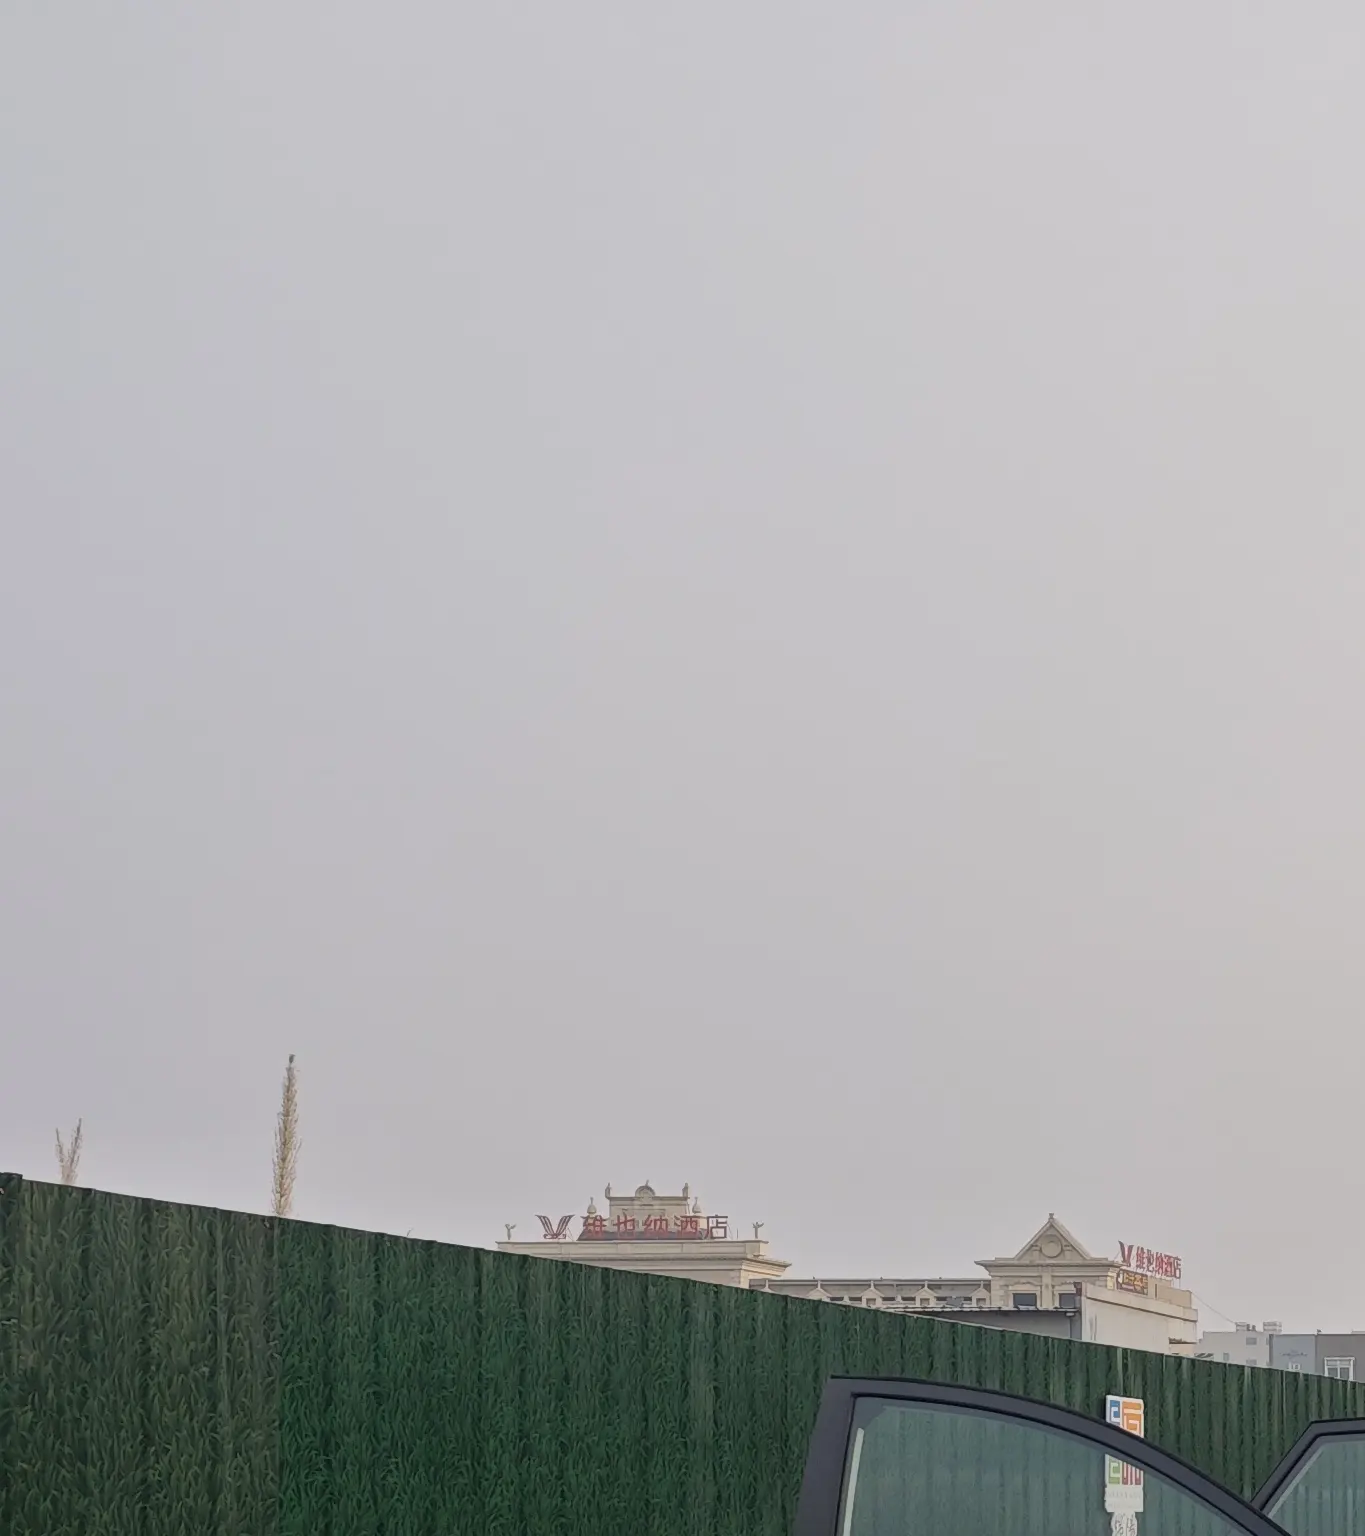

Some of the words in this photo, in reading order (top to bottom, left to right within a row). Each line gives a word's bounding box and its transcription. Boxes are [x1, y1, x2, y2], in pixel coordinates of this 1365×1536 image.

[581, 1214, 728, 1240] 维也纳酒店
